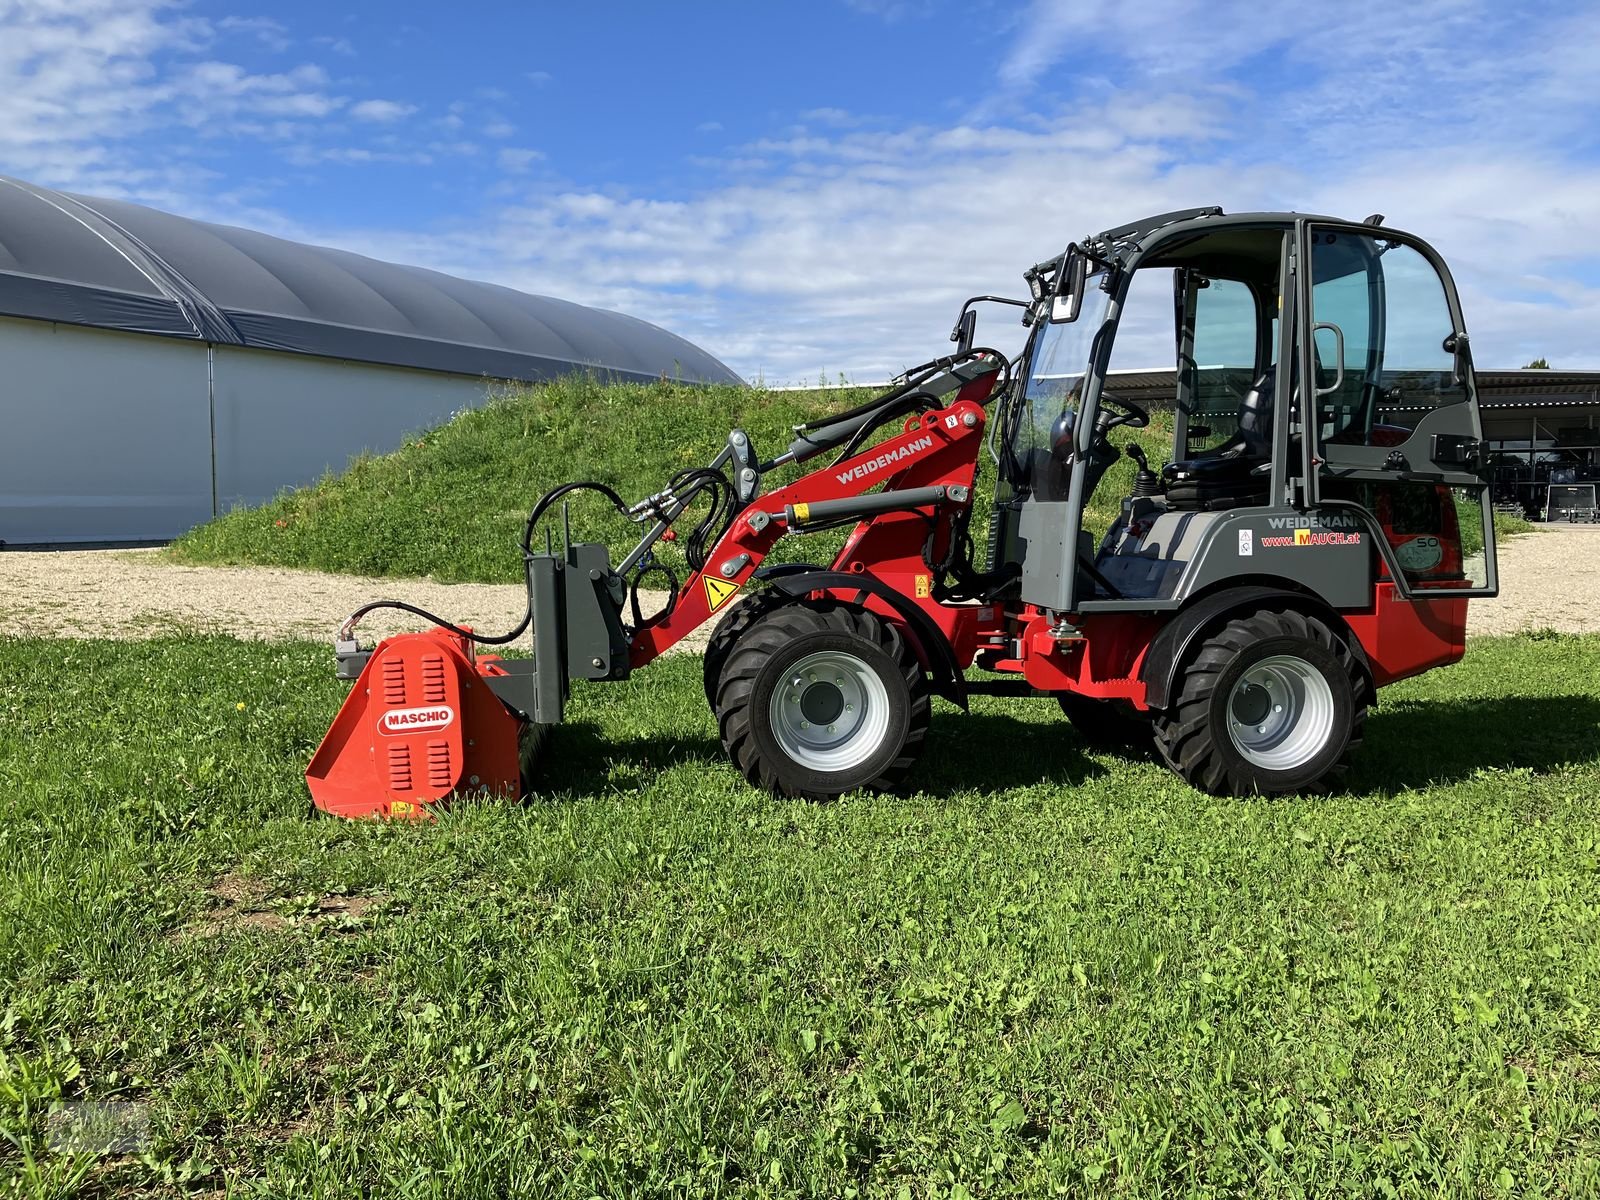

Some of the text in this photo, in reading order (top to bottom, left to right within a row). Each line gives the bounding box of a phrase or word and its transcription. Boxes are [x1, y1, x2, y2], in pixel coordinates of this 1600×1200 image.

[836, 436, 933, 485] WEIDEMANN
[1416, 537, 1438, 548] 50
[387, 710, 449, 726] MASCHIO
